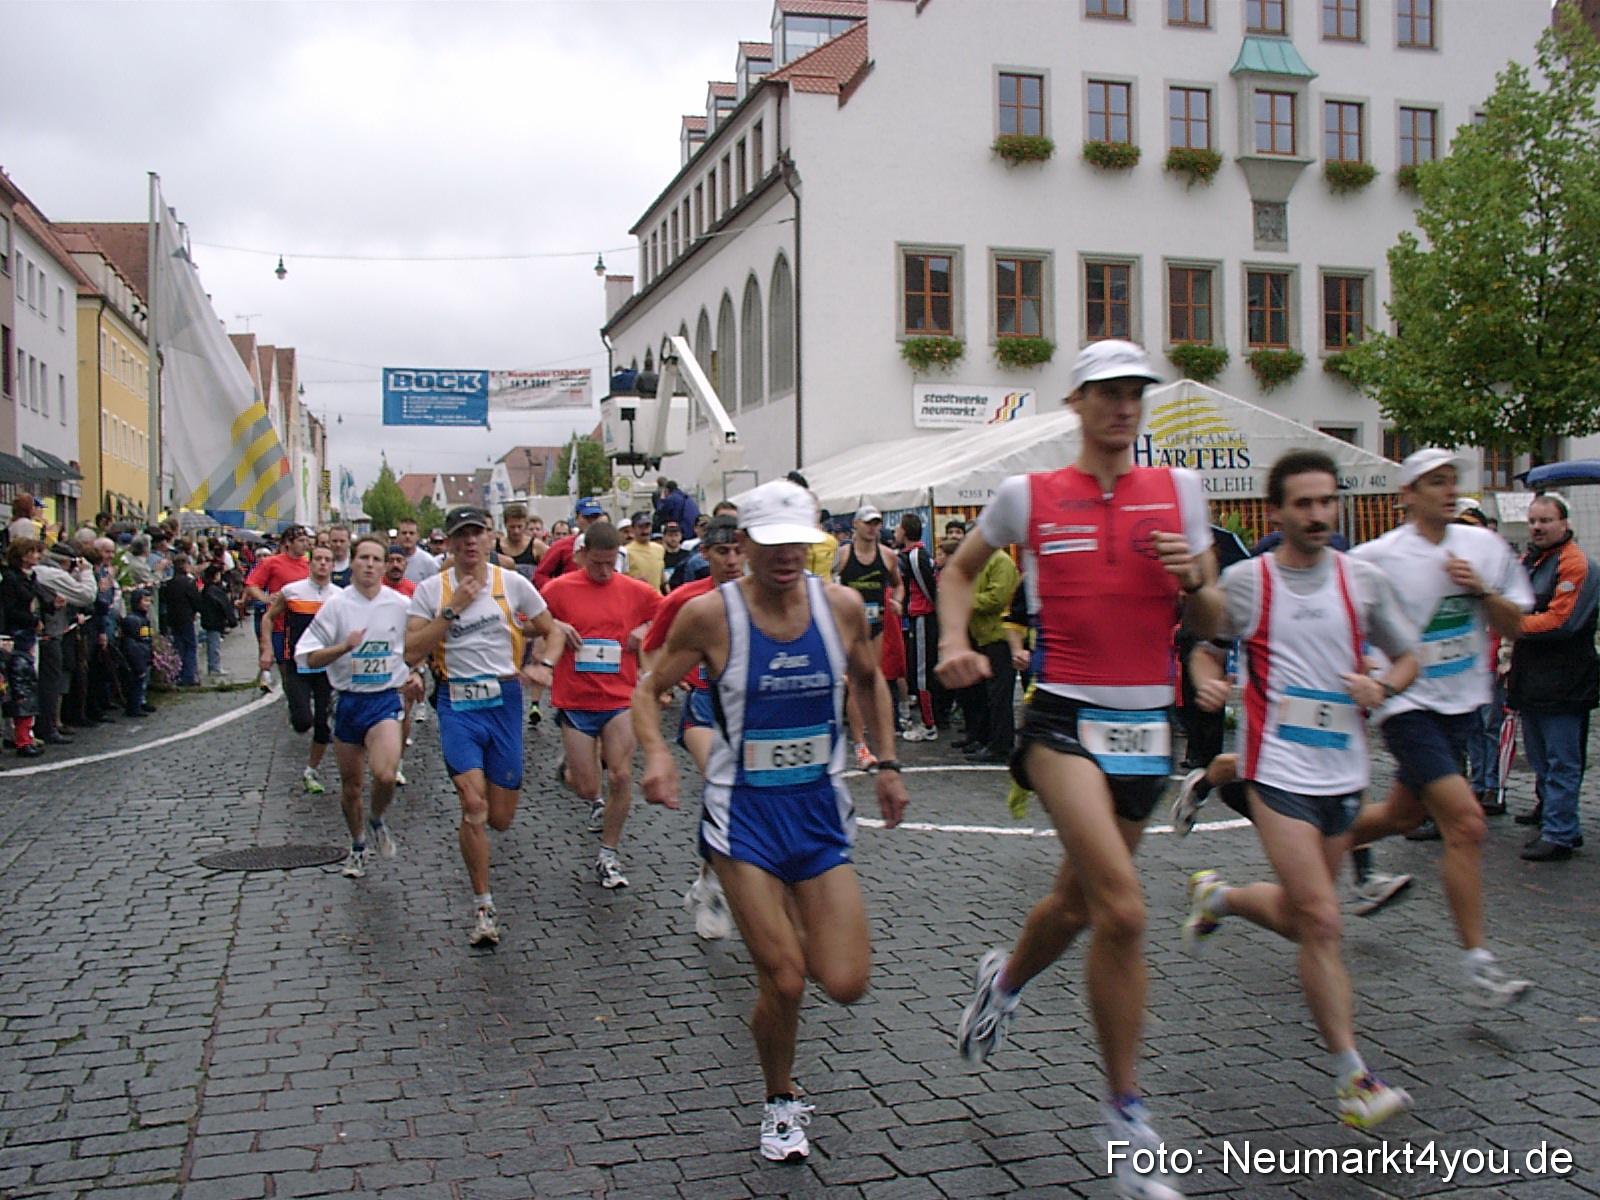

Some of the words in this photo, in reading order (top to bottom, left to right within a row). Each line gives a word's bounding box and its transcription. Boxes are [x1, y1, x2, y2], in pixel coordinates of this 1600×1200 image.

[388, 371, 483, 392] BOCK
[923, 393, 988, 405] stadtwerke
[921, 406, 976, 416] neumarkt
[1201, 476, 1253, 493] RLEIH
[595, 646, 605, 661] 4
[364, 659, 387, 674] 221
[464, 682, 490, 700] 571
[1315, 702, 1332, 728] 6
